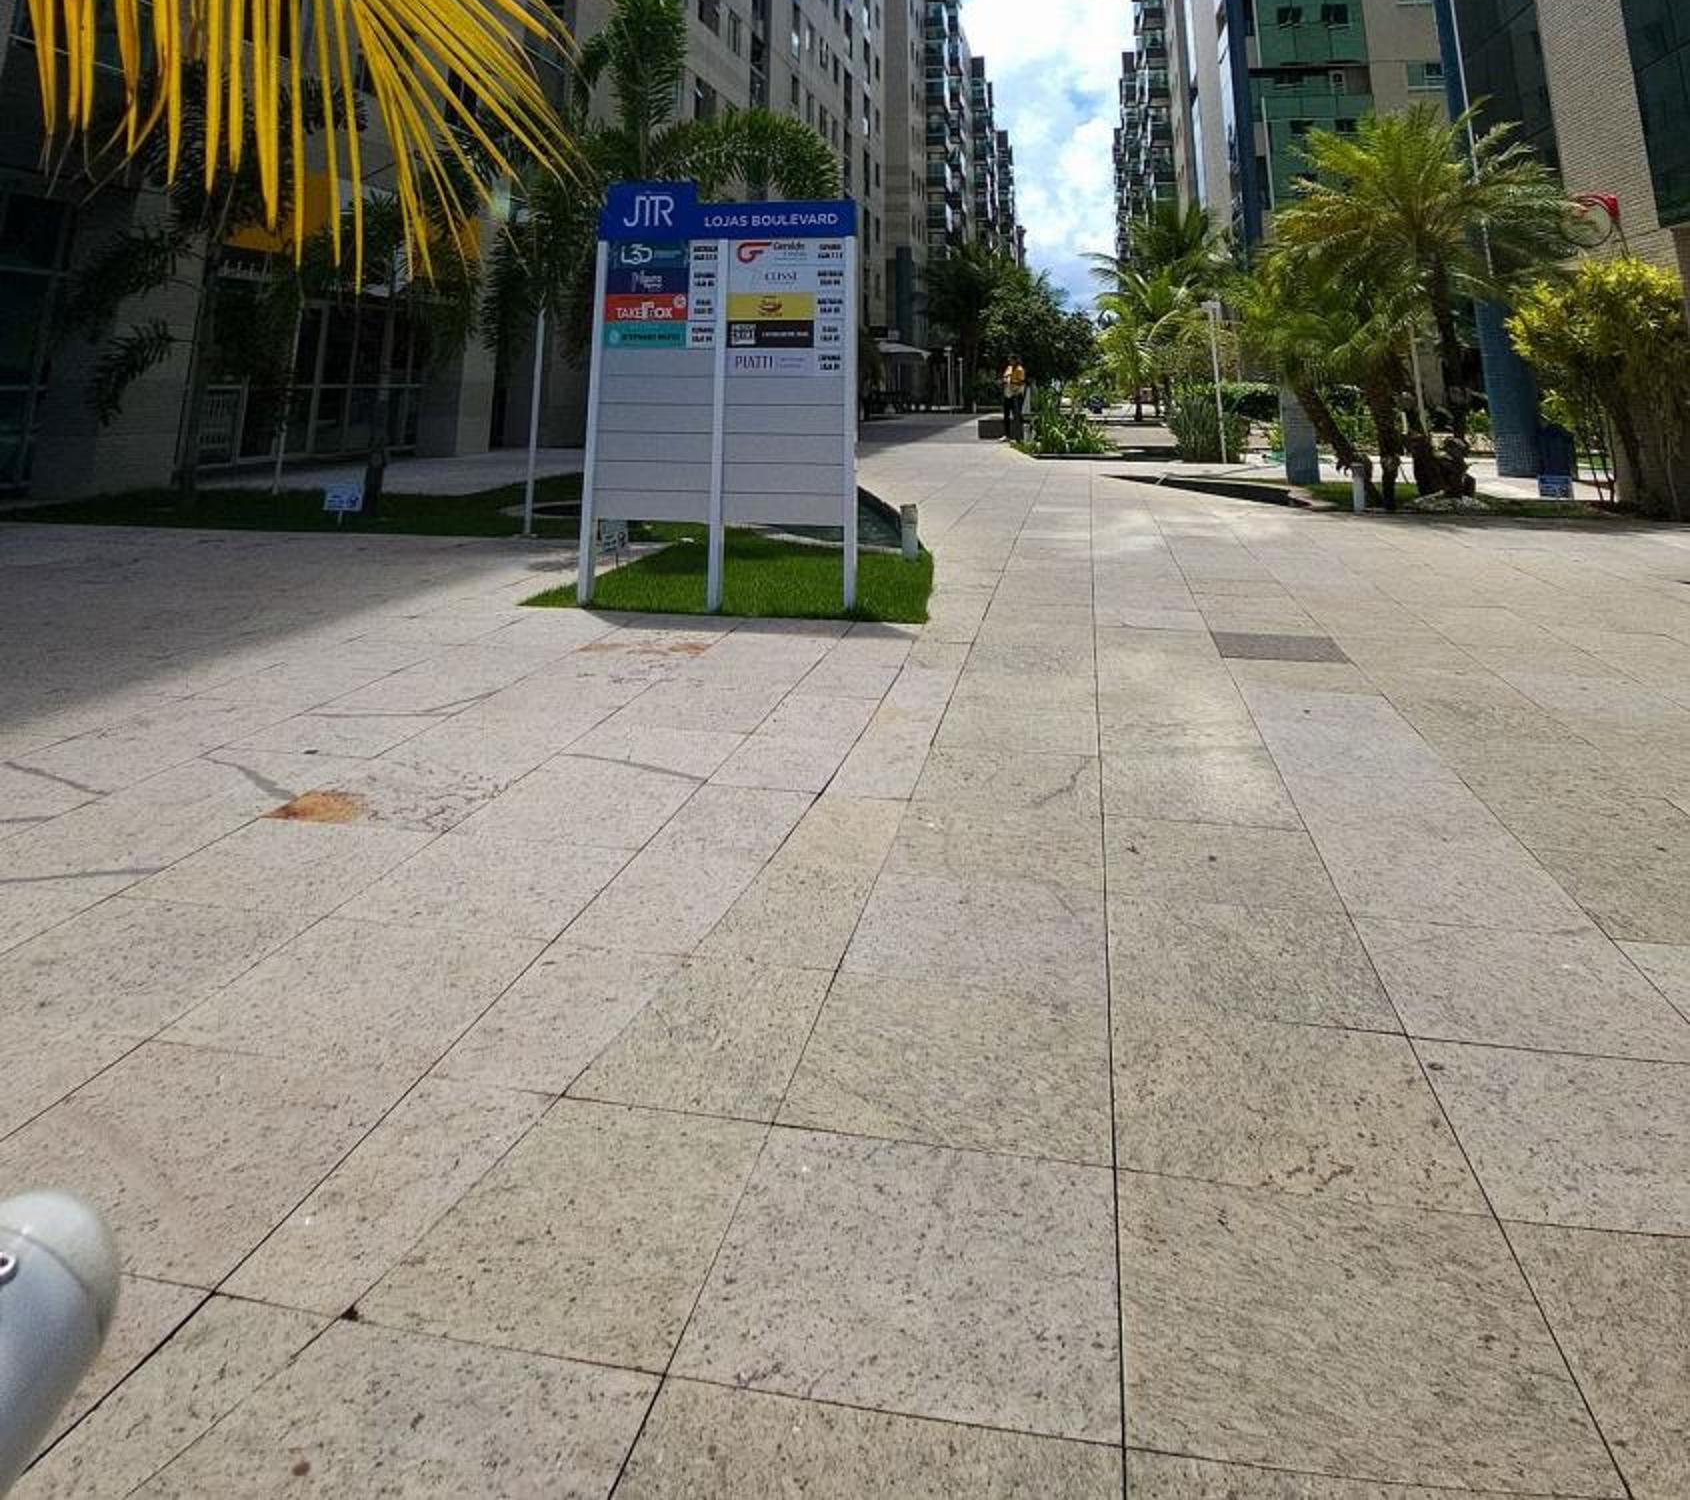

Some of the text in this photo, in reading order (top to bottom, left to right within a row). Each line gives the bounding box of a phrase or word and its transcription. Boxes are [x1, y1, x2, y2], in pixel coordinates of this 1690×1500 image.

[704, 213, 839, 228] LOJAS BOULEVARD
[735, 355, 773, 370] PIATTI
